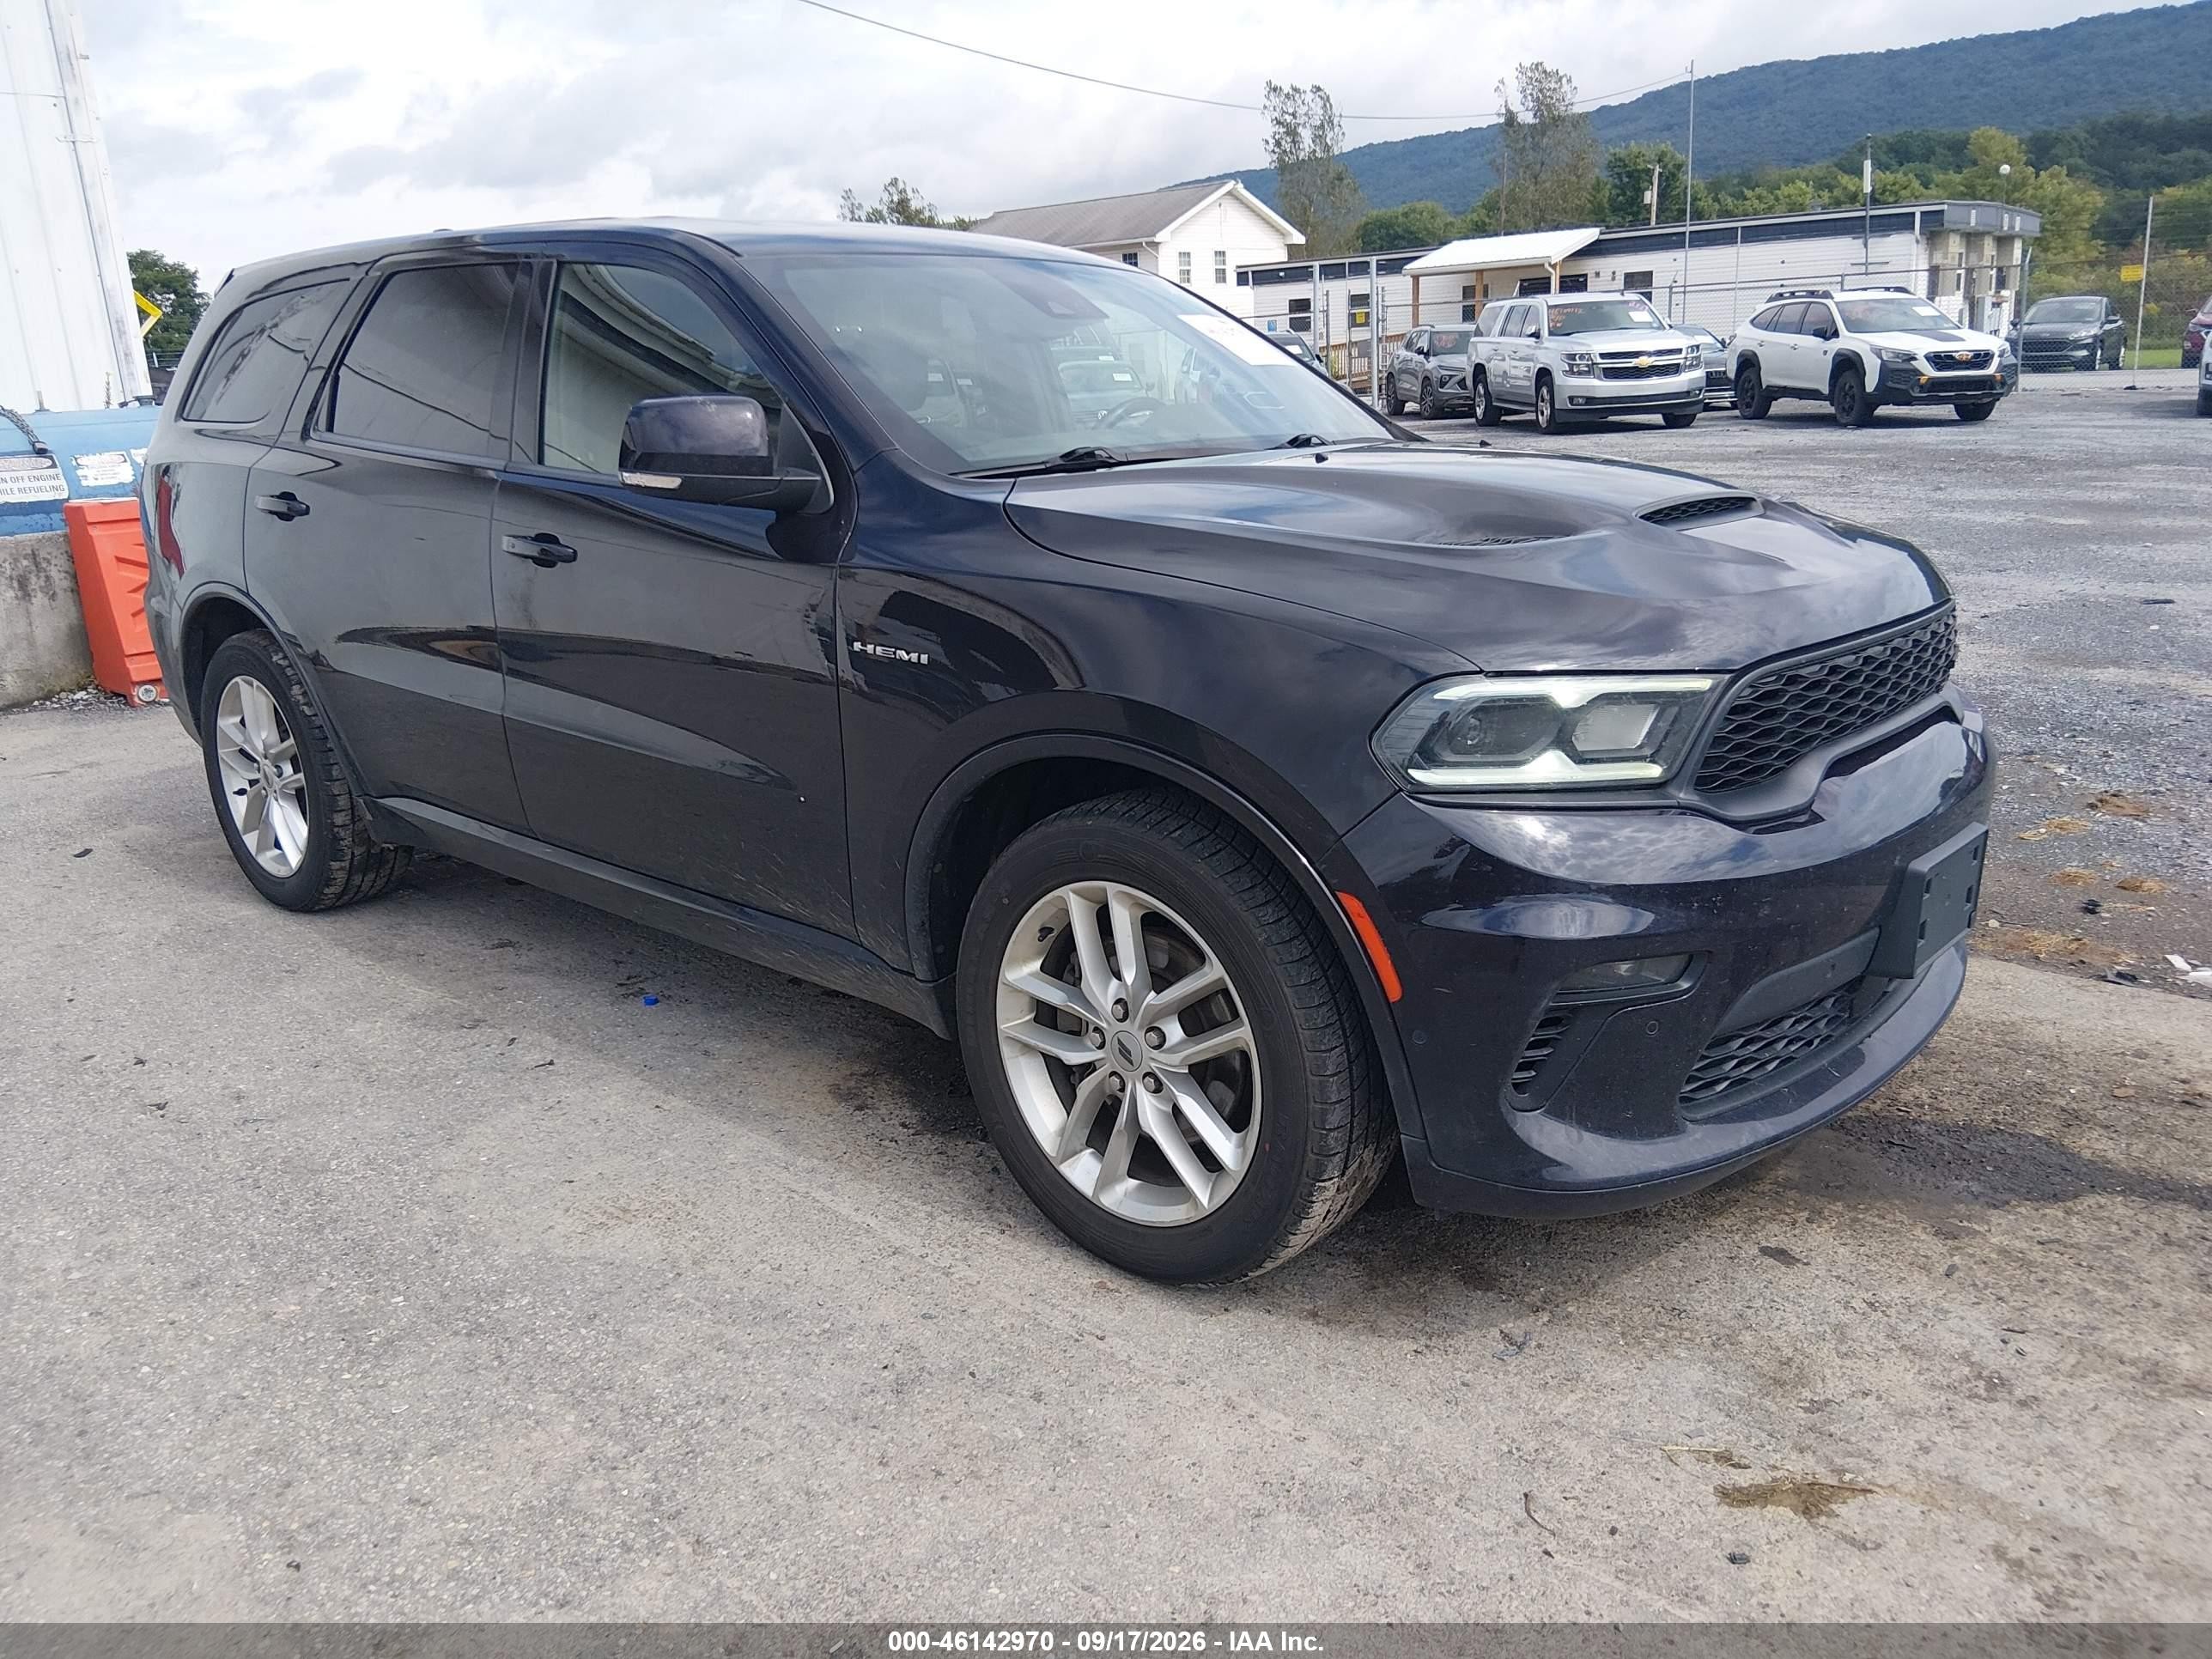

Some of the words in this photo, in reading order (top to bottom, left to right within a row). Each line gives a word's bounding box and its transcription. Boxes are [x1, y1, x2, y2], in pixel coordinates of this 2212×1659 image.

[27, 473, 61, 483] ENGINE
[17, 484, 65, 495] REFUELING
[853, 641, 929, 665] HEMI
